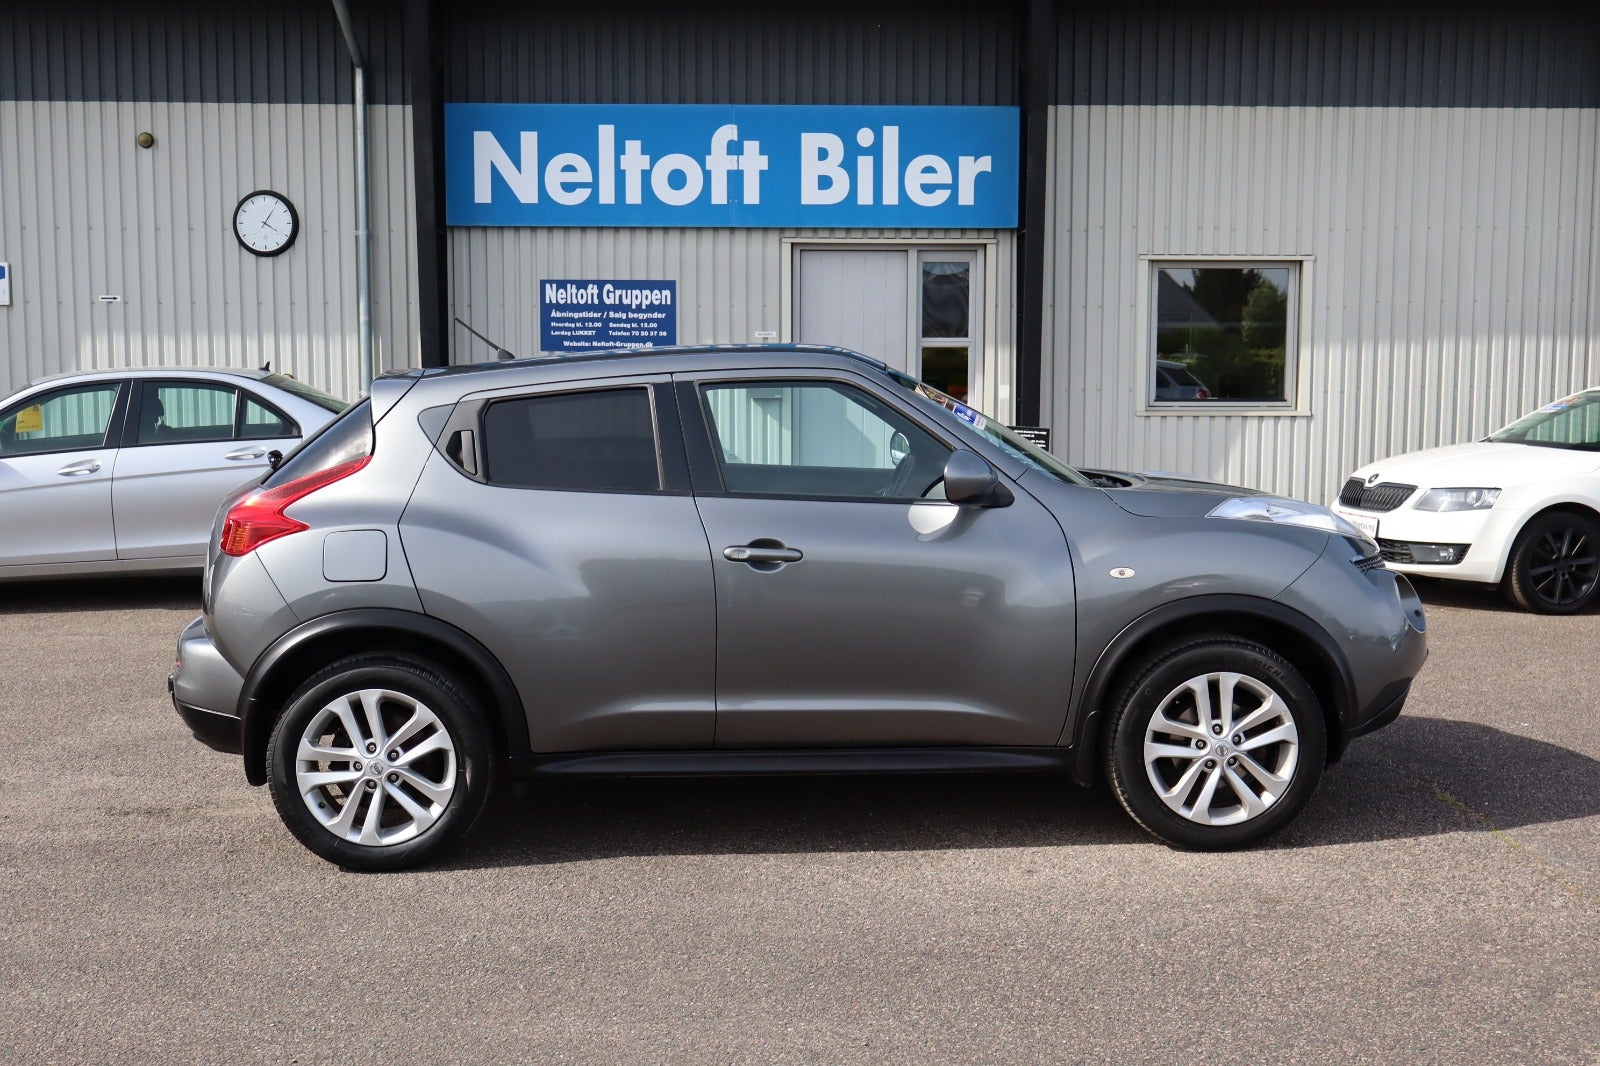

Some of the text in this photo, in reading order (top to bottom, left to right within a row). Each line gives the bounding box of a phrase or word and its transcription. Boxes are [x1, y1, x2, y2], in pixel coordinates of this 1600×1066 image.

[473, 123, 992, 207] Neltoft Biler
[545, 283, 671, 309] Neltoft Gruppen
[550, 308, 602, 319] Åbningstider
[609, 311, 627, 320] Salg
[628, 311, 667, 320] begynder
[551, 321, 576, 329] Hverdag
